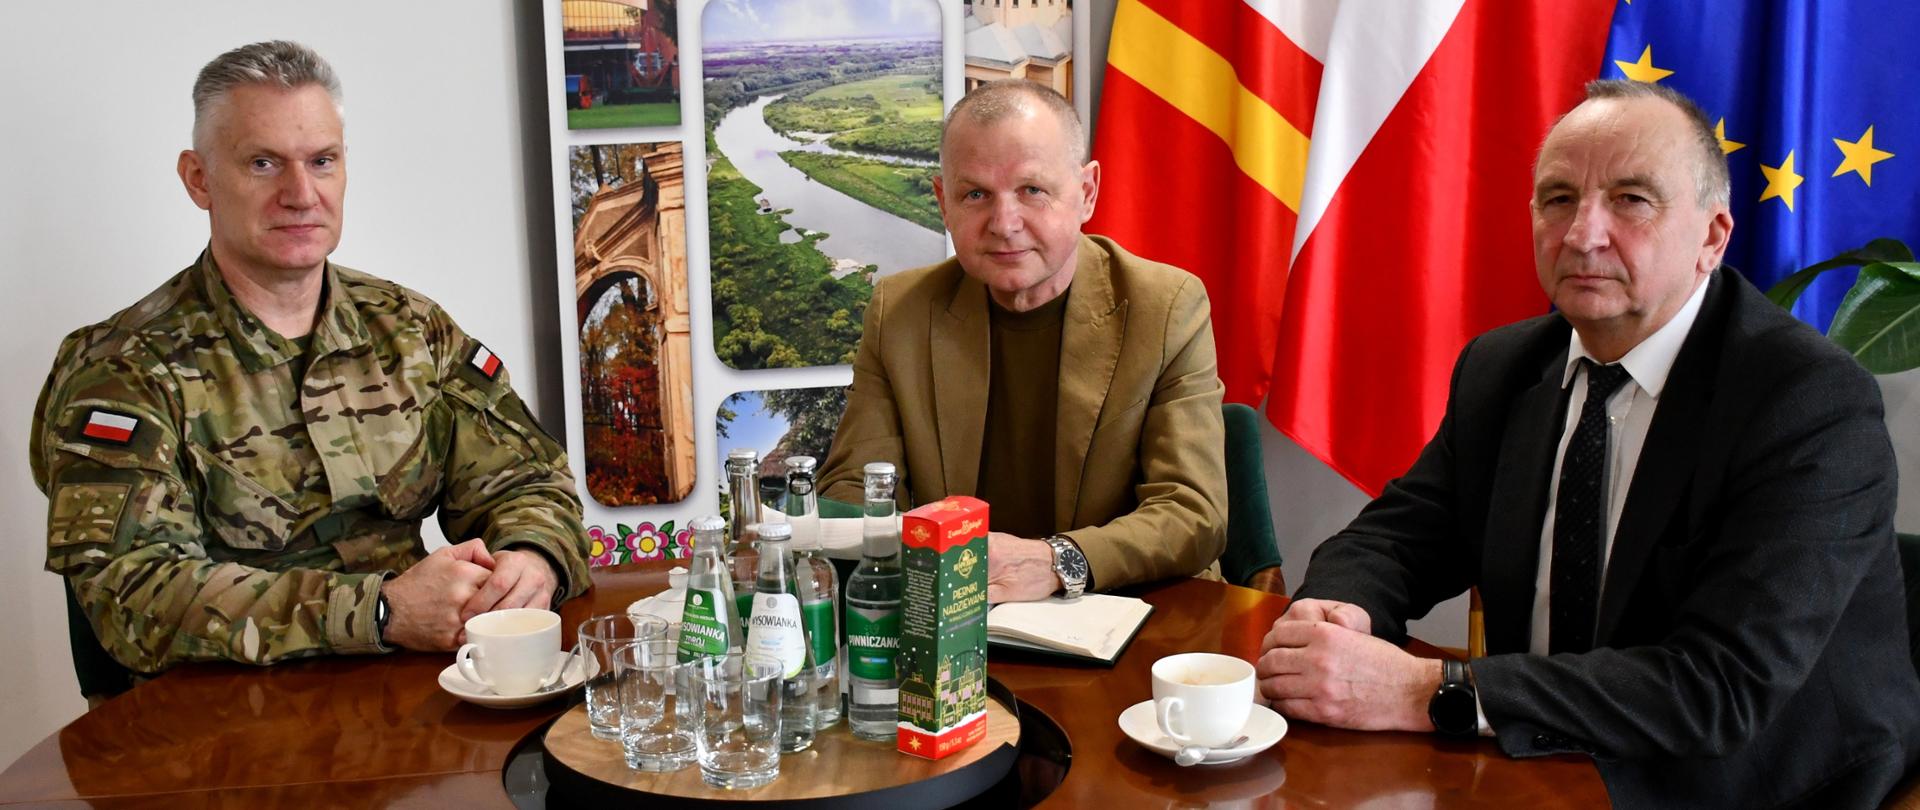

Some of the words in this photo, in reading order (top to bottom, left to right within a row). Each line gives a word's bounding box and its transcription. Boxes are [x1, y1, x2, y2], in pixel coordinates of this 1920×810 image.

[943, 590, 986, 617] NADZIEWANE
[680, 622, 725, 642] SOWIANKA
[848, 634, 900, 648] PIWNICZANK
